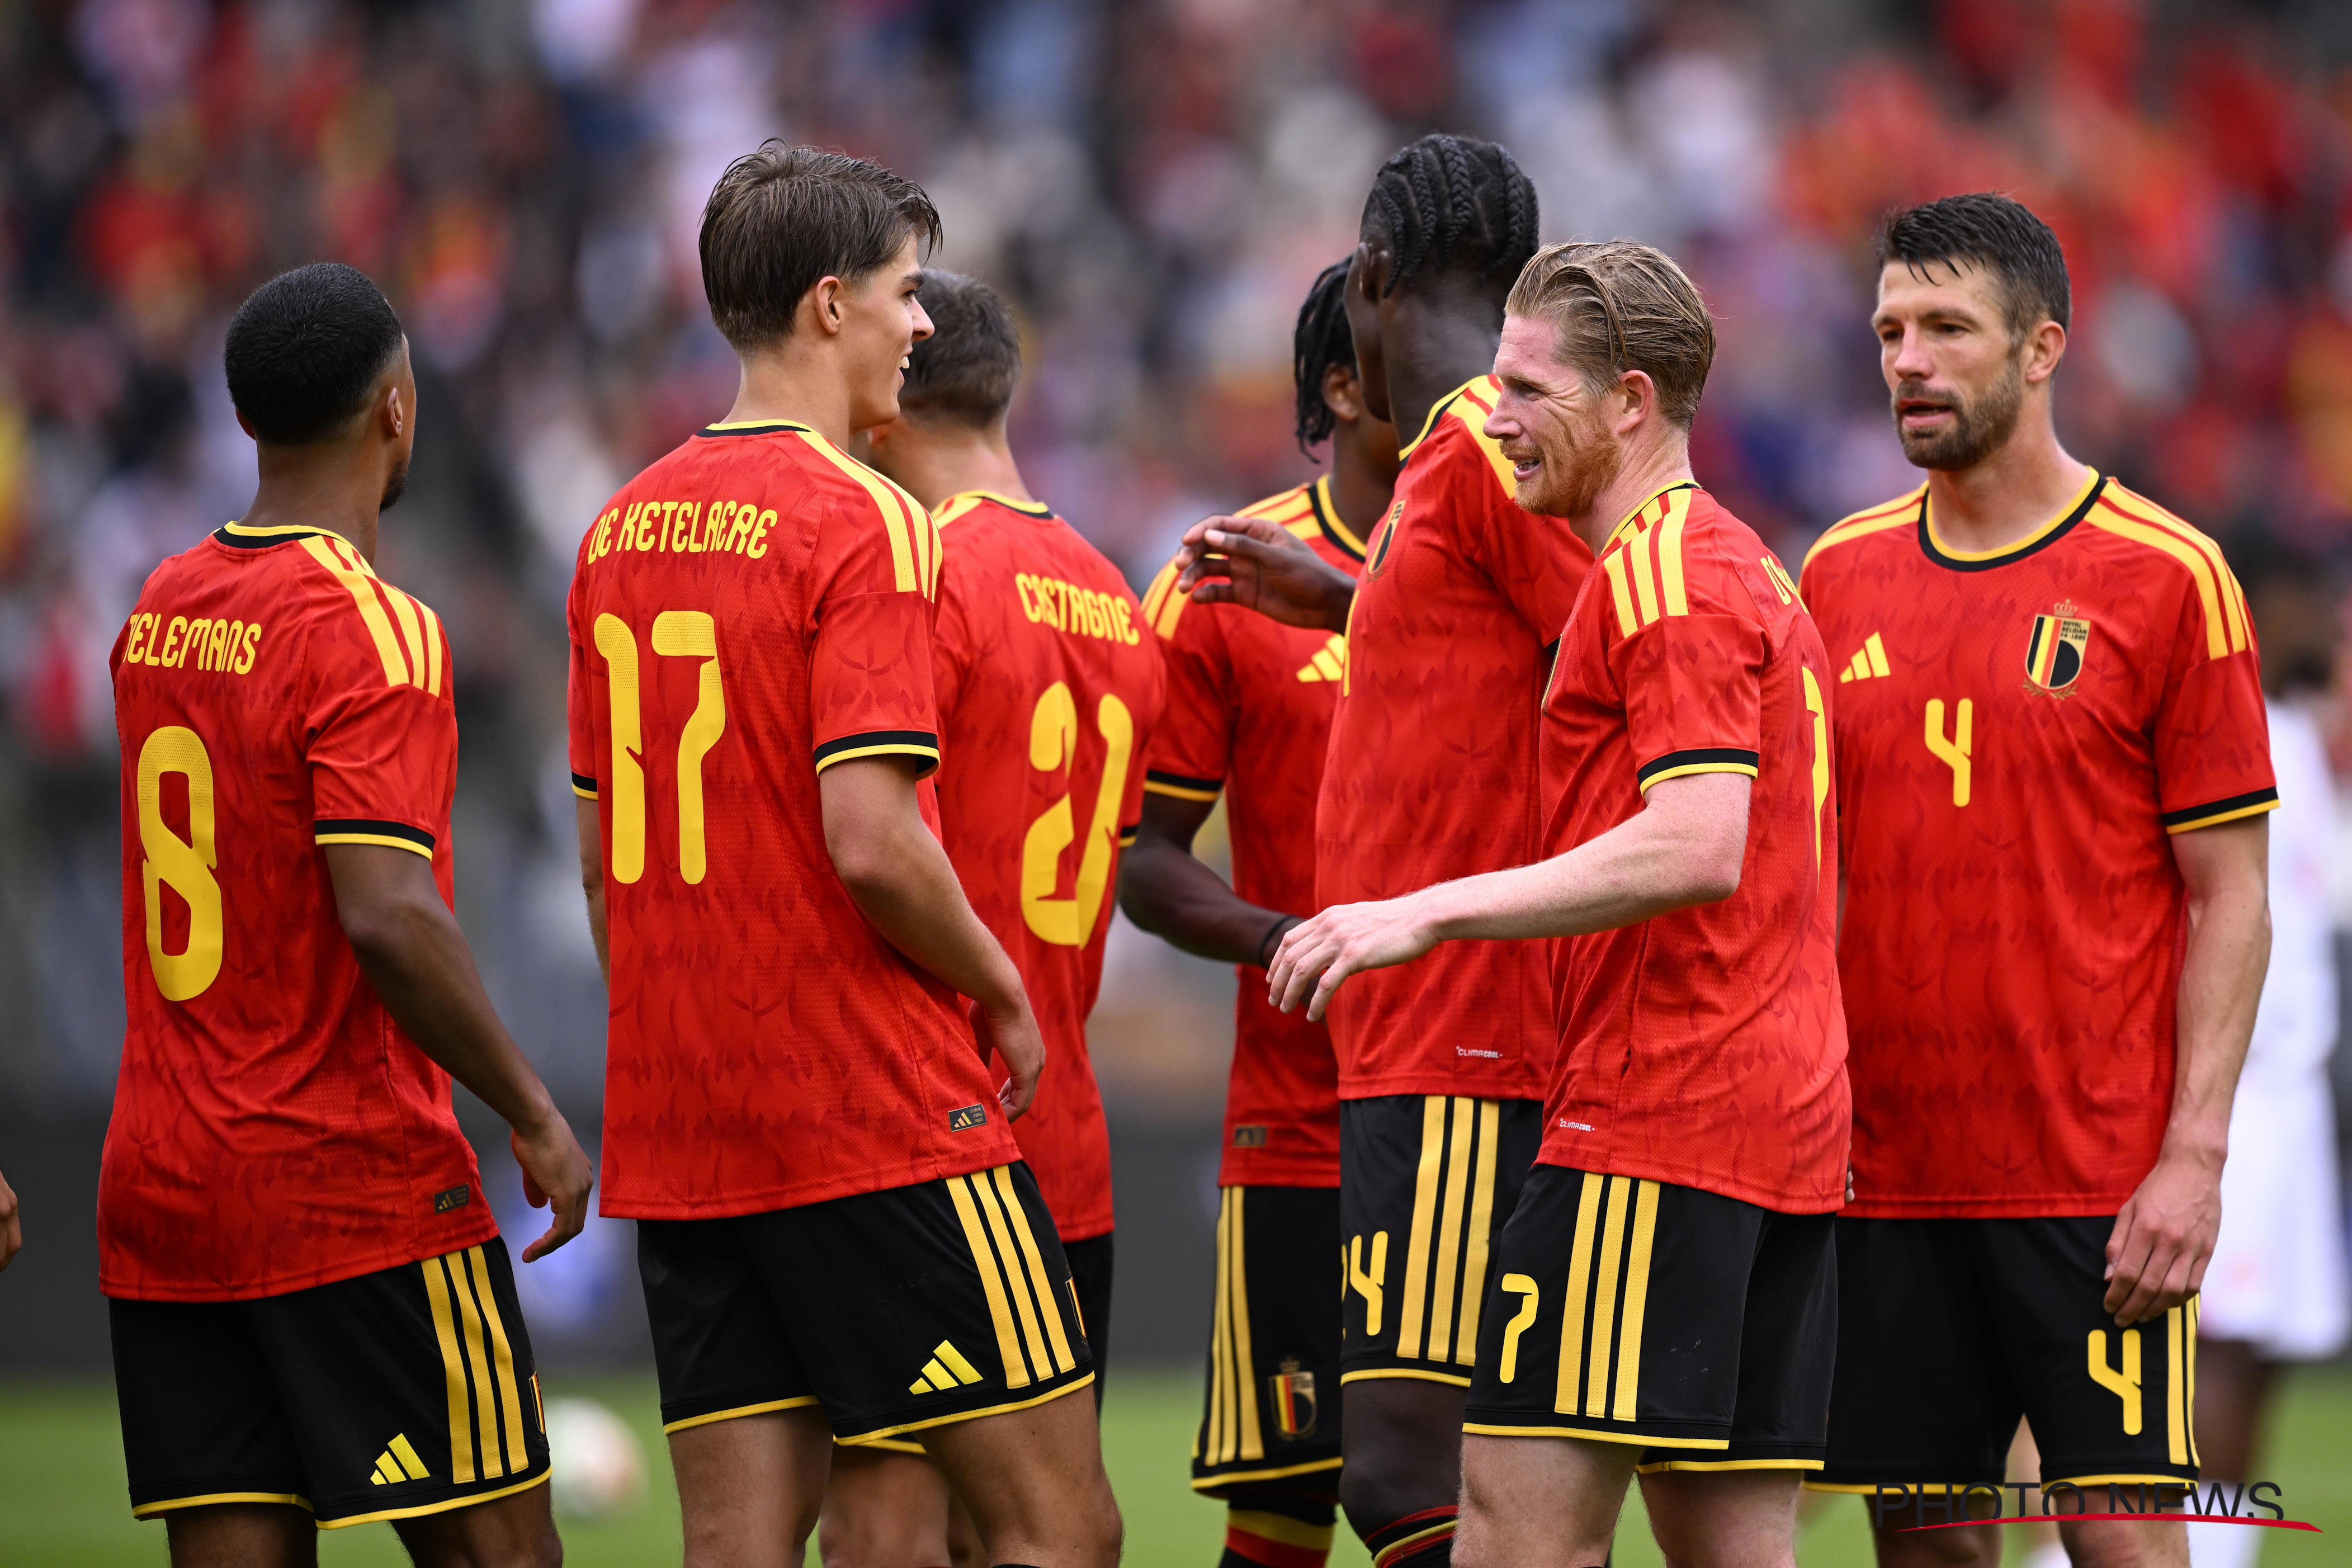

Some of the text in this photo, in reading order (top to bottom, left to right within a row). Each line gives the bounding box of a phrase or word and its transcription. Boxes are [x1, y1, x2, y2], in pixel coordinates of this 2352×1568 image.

[588, 500, 778, 565] DE KETELAERE
[593, 610, 726, 885] 17
[1924, 698, 1973, 807] 4
[137, 726, 223, 1001] 8
[1021, 681, 1133, 950] 21
[1342, 1231, 1388, 1340] 4
[1499, 1273, 1539, 1383] 7
[2087, 1329, 2142, 1435] 4
